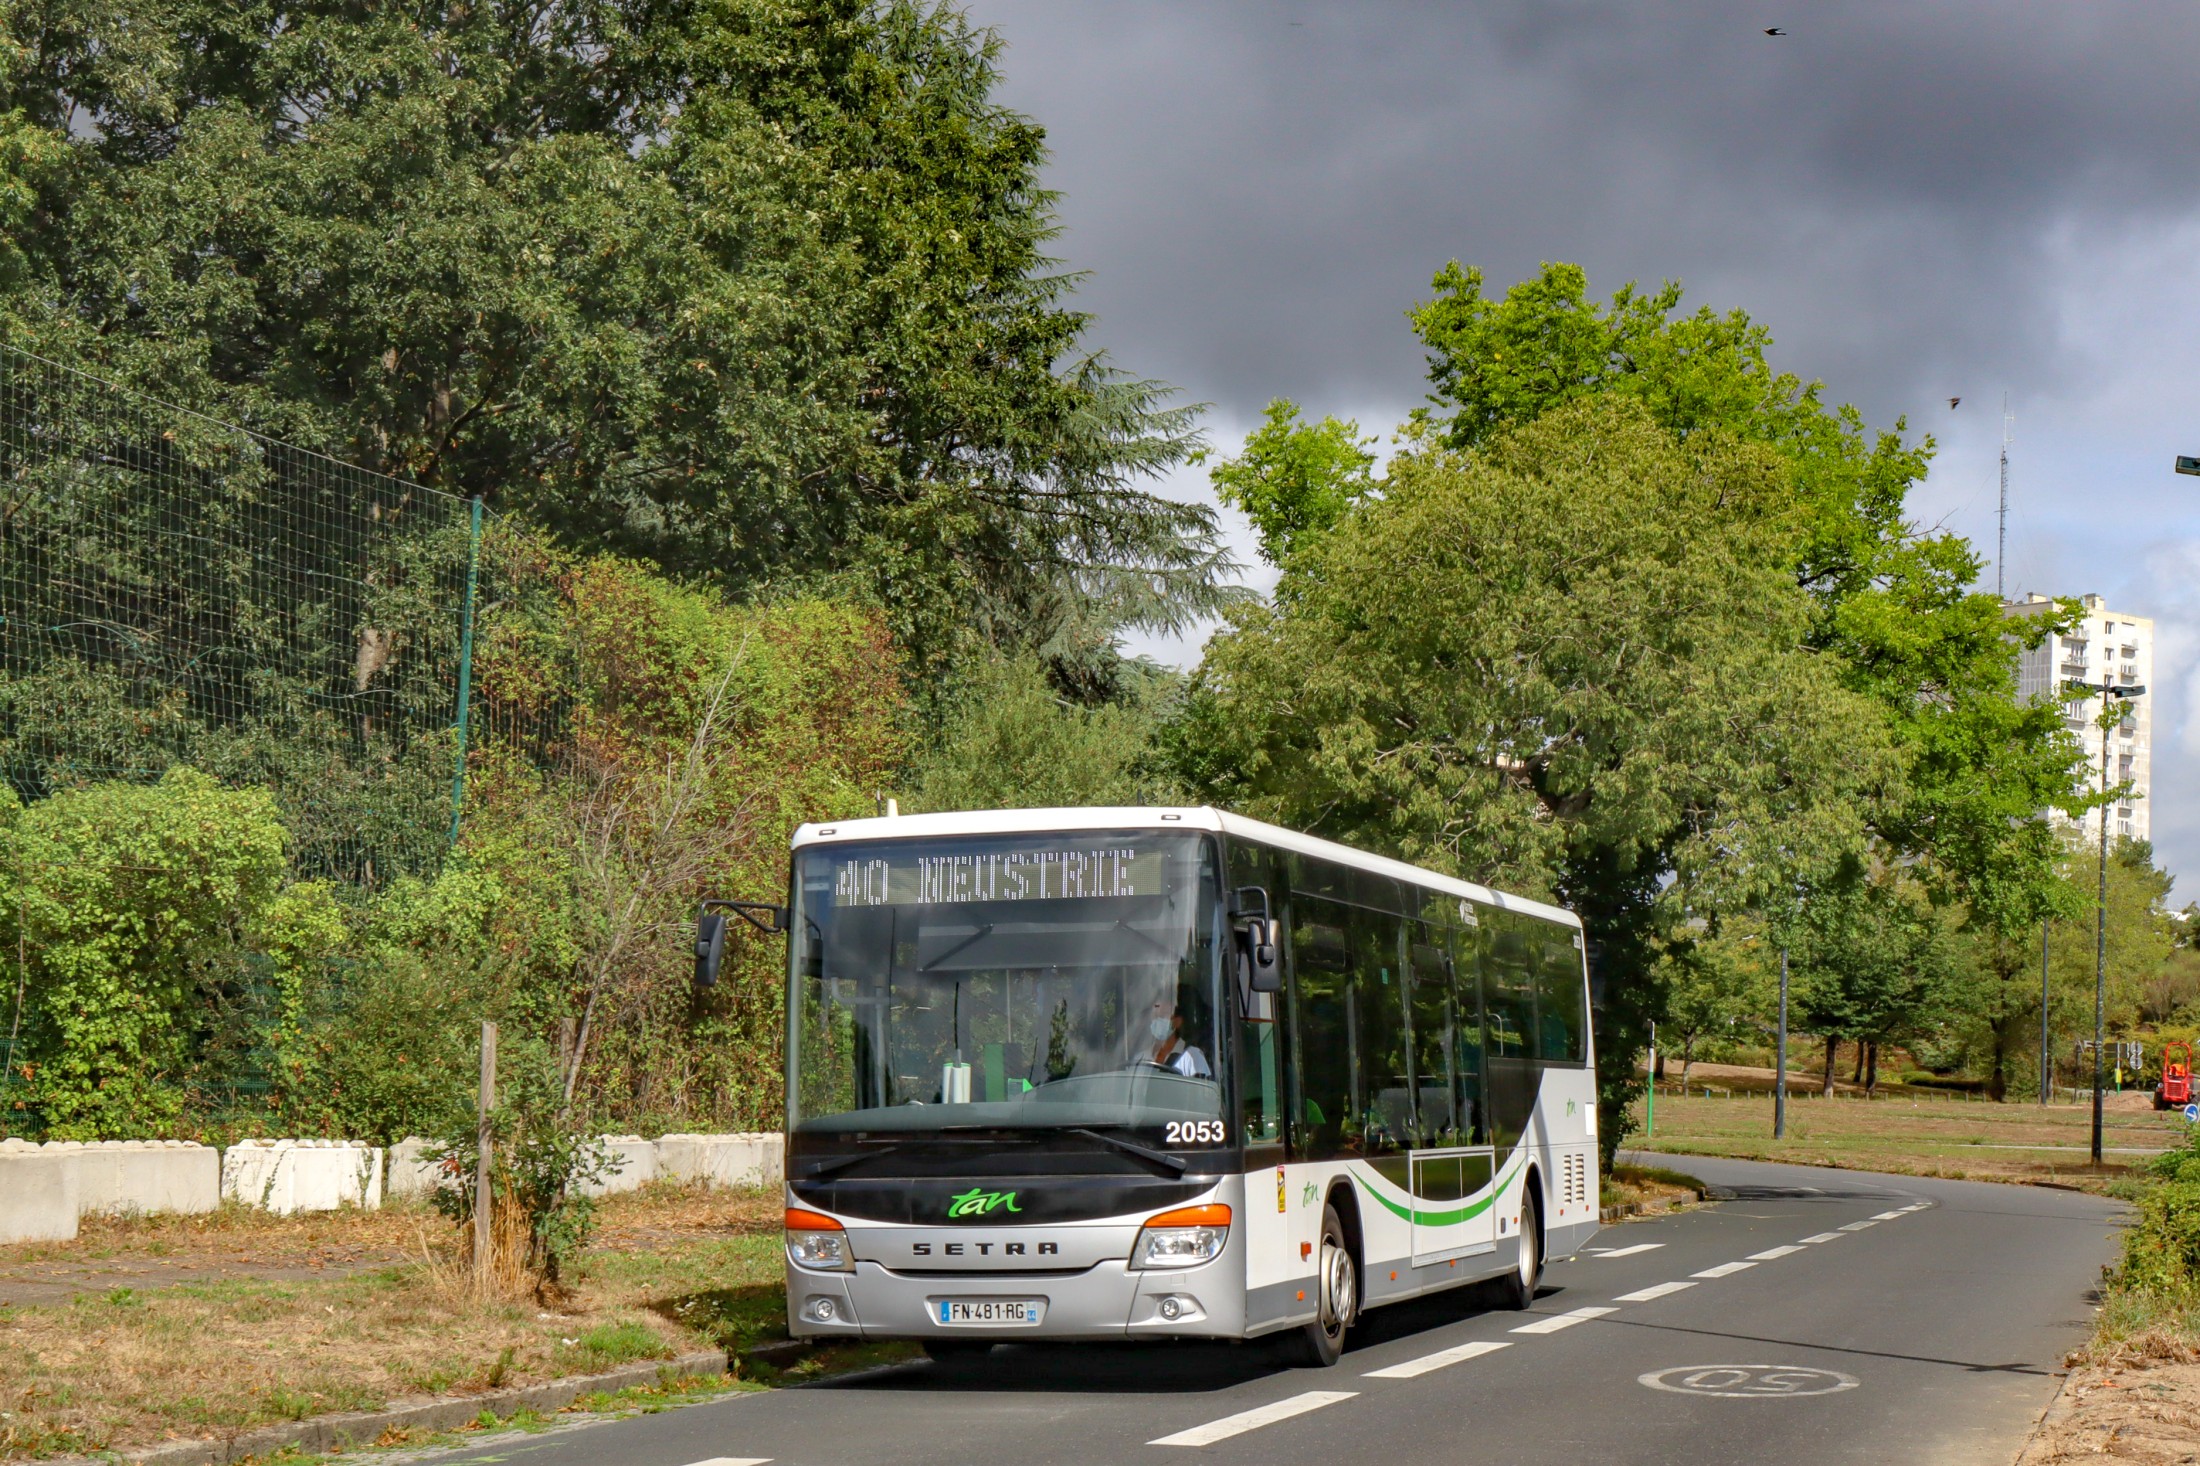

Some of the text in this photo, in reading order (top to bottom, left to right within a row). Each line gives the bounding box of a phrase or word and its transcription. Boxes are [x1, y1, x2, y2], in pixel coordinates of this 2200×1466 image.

[835, 849, 1134, 906] 40 NEUSTRIE
[1165, 1120, 1225, 1143] 2053
[948, 1188, 1022, 1217] tan
[912, 1242, 1058, 1256] SETRA
[952, 1303, 1024, 1320] FN-481-RG
